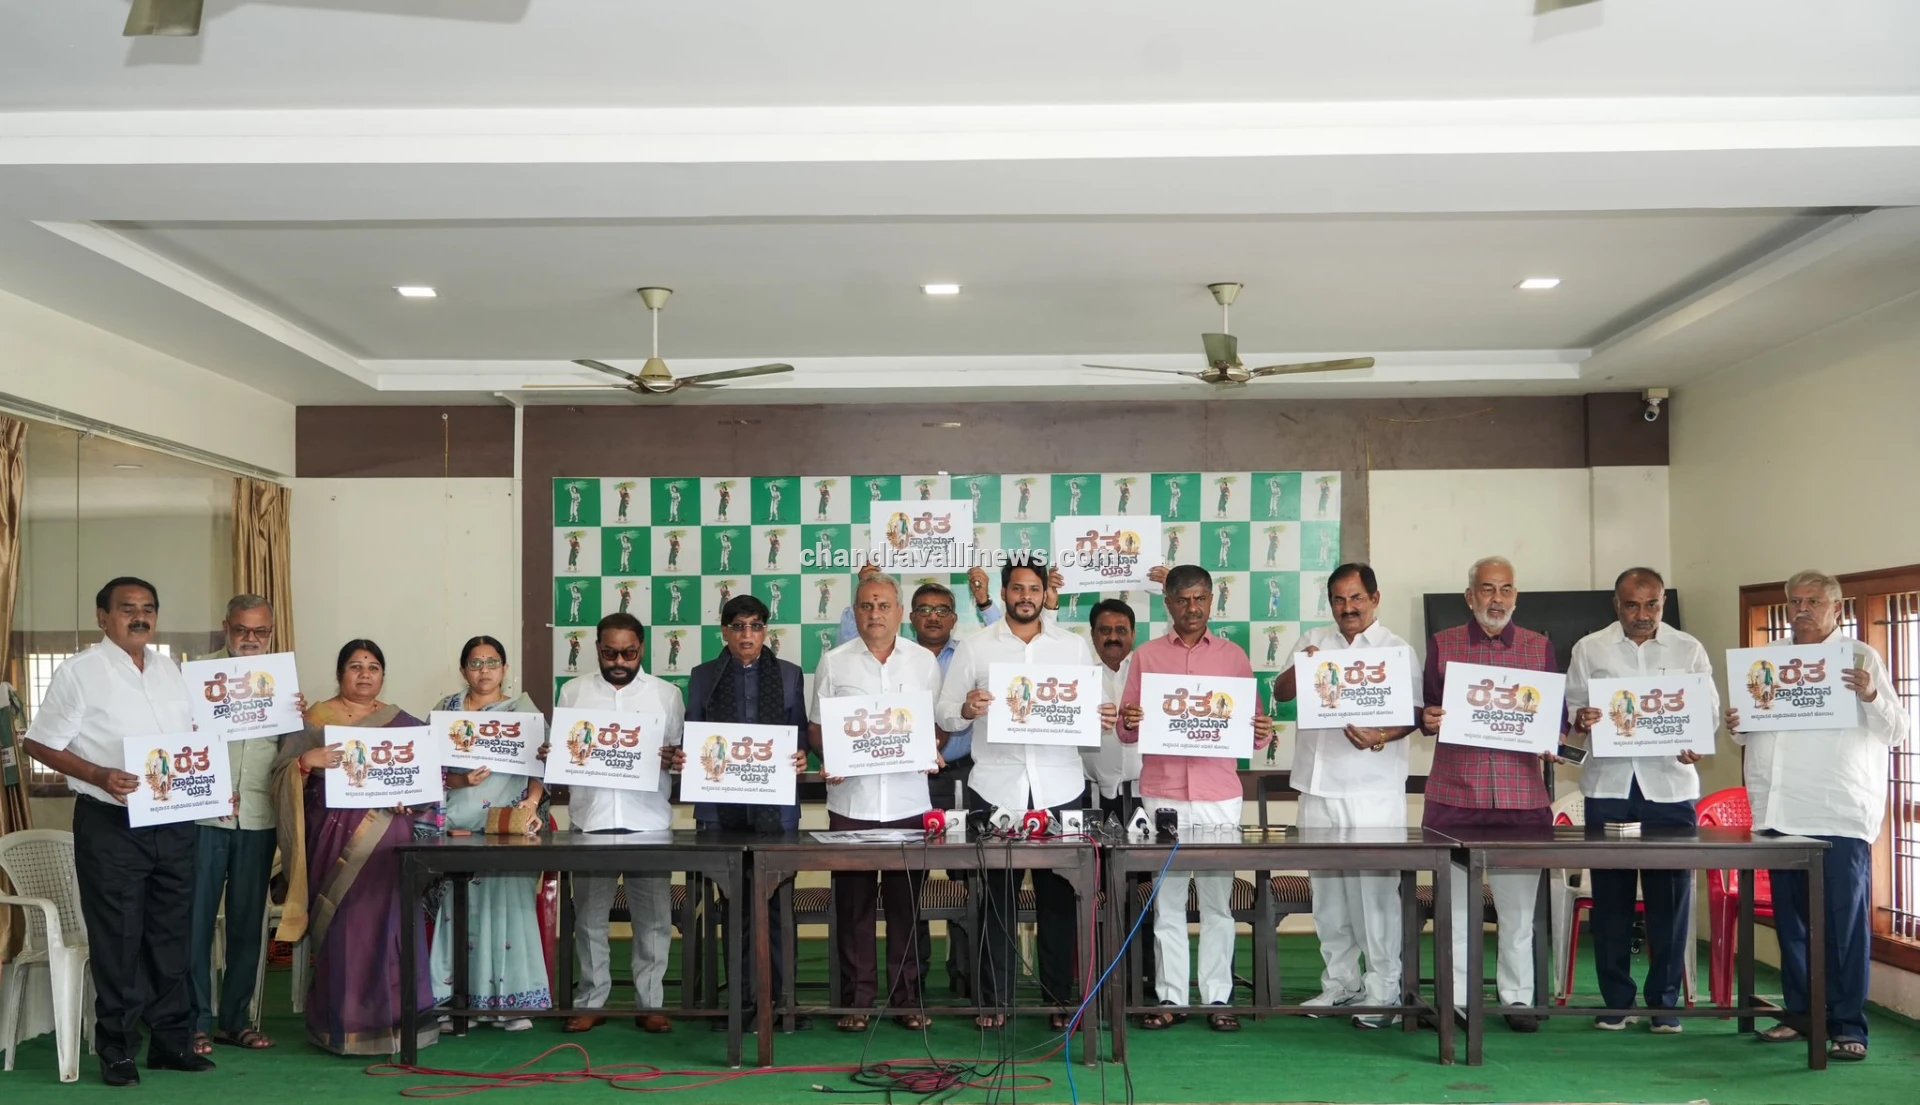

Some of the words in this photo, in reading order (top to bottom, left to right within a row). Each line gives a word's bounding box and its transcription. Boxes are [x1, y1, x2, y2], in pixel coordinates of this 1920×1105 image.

[913, 512, 951, 535] ರೈತ
[1101, 565, 1132, 576] ಯಾತ್ರೆ
[1344, 660, 1386, 686] ರೈತ
[1779, 658, 1826, 685] ರೈತ
[204, 671, 252, 704] ರೈತ
[1037, 677, 1078, 704] ರೈತ
[1341, 686, 1392, 700] ಸ್ವಾಭಿಮಾನ
[1467, 678, 1519, 711] ರೈತ
[1775, 686, 1831, 701] ಸ್ವಾಭಿಮಾನ
[213, 698, 273, 719] ಸ್ವಾಭಿಮಾನ
[1162, 688, 1212, 719] ರೈತ
[1357, 696, 1386, 707] ಯಾತ್ರೆ
[1640, 688, 1685, 715] ರೈತ
[1792, 696, 1825, 708] ಯಾತ್ರೆ
[232, 708, 267, 724] ಯಾತ್ರೆ
[1031, 704, 1081, 717] ಸ್ವಾಭಿಮಾನ
[1472, 708, 1533, 725] ಸ್ವಾಭಿಮಾನ
[844, 707, 892, 738] ರೈತ
[1046, 714, 1074, 726] ಯಾತ್ರೆ
[1169, 717, 1229, 733] ಸ್ವಾಭಿಮಾನ
[1636, 715, 1690, 728] ಸ್ವಾಭಿಮಾನ
[479, 720, 521, 739] ರೈತ
[597, 722, 641, 749] ರೈತ
[1187, 729, 1221, 741] ಯಾತ್ರೆ
[1491, 722, 1525, 735] ಯಾತ್ರೆ
[1653, 724, 1684, 735] ಯಾತ್ರೆ
[475, 738, 525, 750] ಸ್ವಾಭಿಮಾನ
[731, 737, 773, 763] ರೈತ
[852, 733, 910, 752] ಸ್ವಾಭಿಮಾನ
[371, 740, 415, 767] ರೈತ
[490, 745, 519, 756] ಯಾತ್ರೆ
[591, 748, 641, 761] ಸ್ವಾಭಿಮಾನ
[871, 745, 905, 757] ಯಾತ್ರೆ
[174, 746, 210, 775] ರೈತ
[605, 758, 634, 770] ಯಾತ್ರೆ
[368, 765, 419, 779] ಸ್ವಾಭಿಮಾನ
[725, 763, 776, 776] ಸ್ವಾಭಿಮಾನ
[172, 774, 215, 792] ಸ್ವಾಭಿಮಾನ
[384, 776, 415, 786] ಯಾತ್ರೆ
[740, 772, 769, 783] ಯಾತ್ರೆ
[187, 785, 212, 797] ಯಾತ್ರೆ
